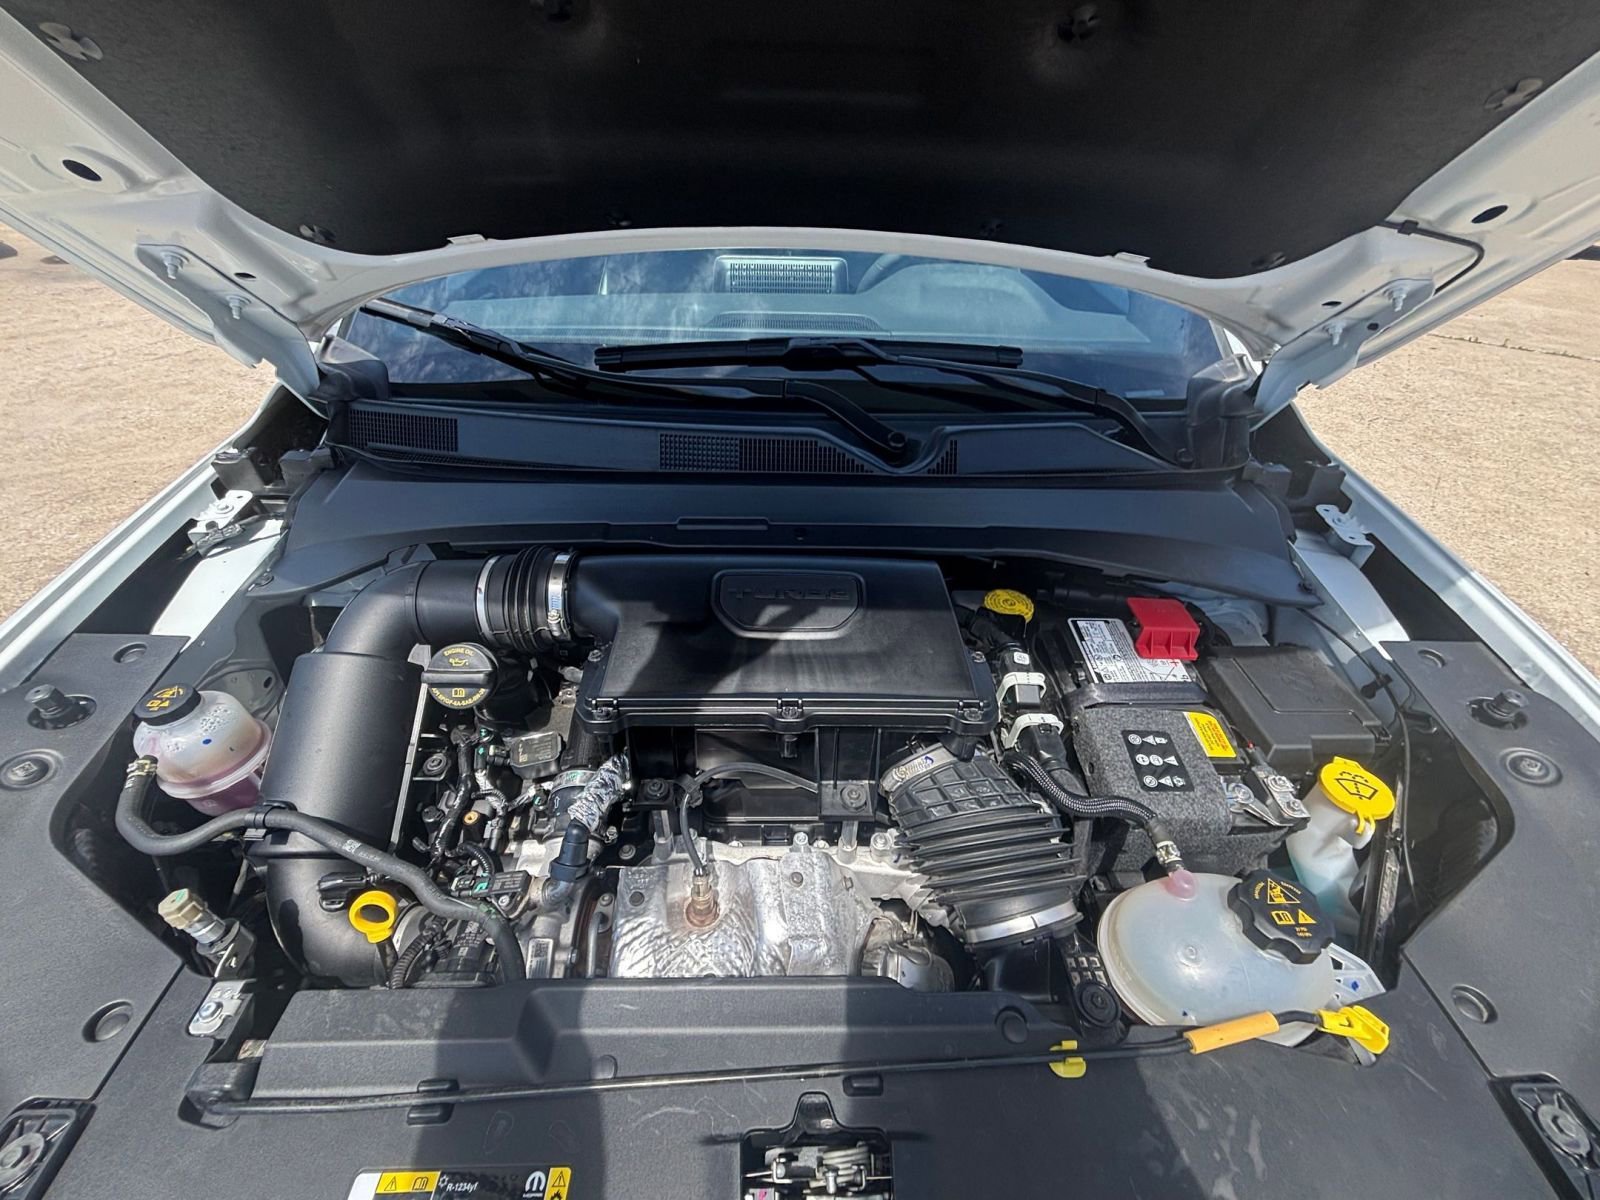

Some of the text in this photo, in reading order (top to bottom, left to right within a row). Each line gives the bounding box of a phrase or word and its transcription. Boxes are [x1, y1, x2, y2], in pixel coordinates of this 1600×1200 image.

[444, 648, 475, 656] ENGINE OIL
[446, 1182, 478, 1193] R-1234yf
